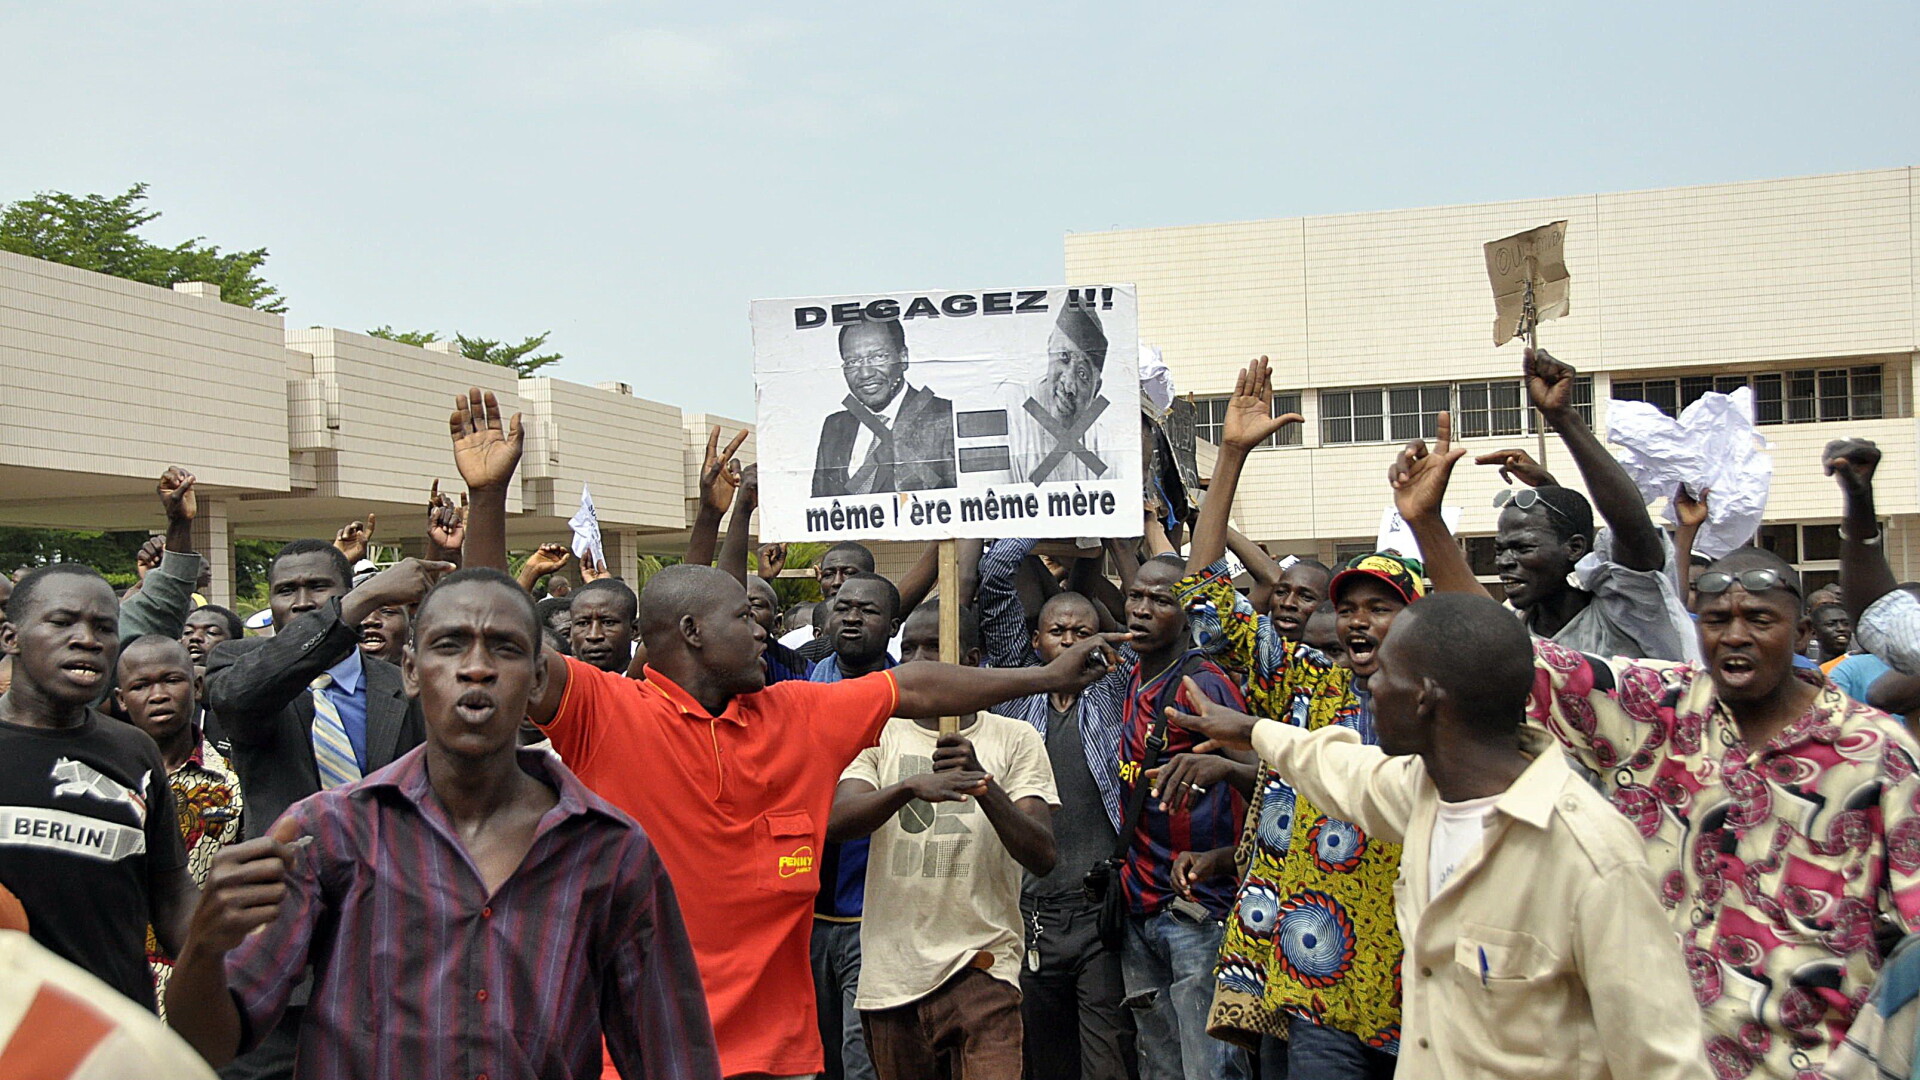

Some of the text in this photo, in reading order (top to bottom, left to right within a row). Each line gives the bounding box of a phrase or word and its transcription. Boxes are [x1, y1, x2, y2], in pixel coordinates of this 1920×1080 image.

[794, 289, 1049, 330] DEGAGEZ
[806, 498, 885, 532] même
[960, 487, 1039, 522] même
[1047, 482, 1116, 517] mère
[14, 817, 105, 848] BERLIN
